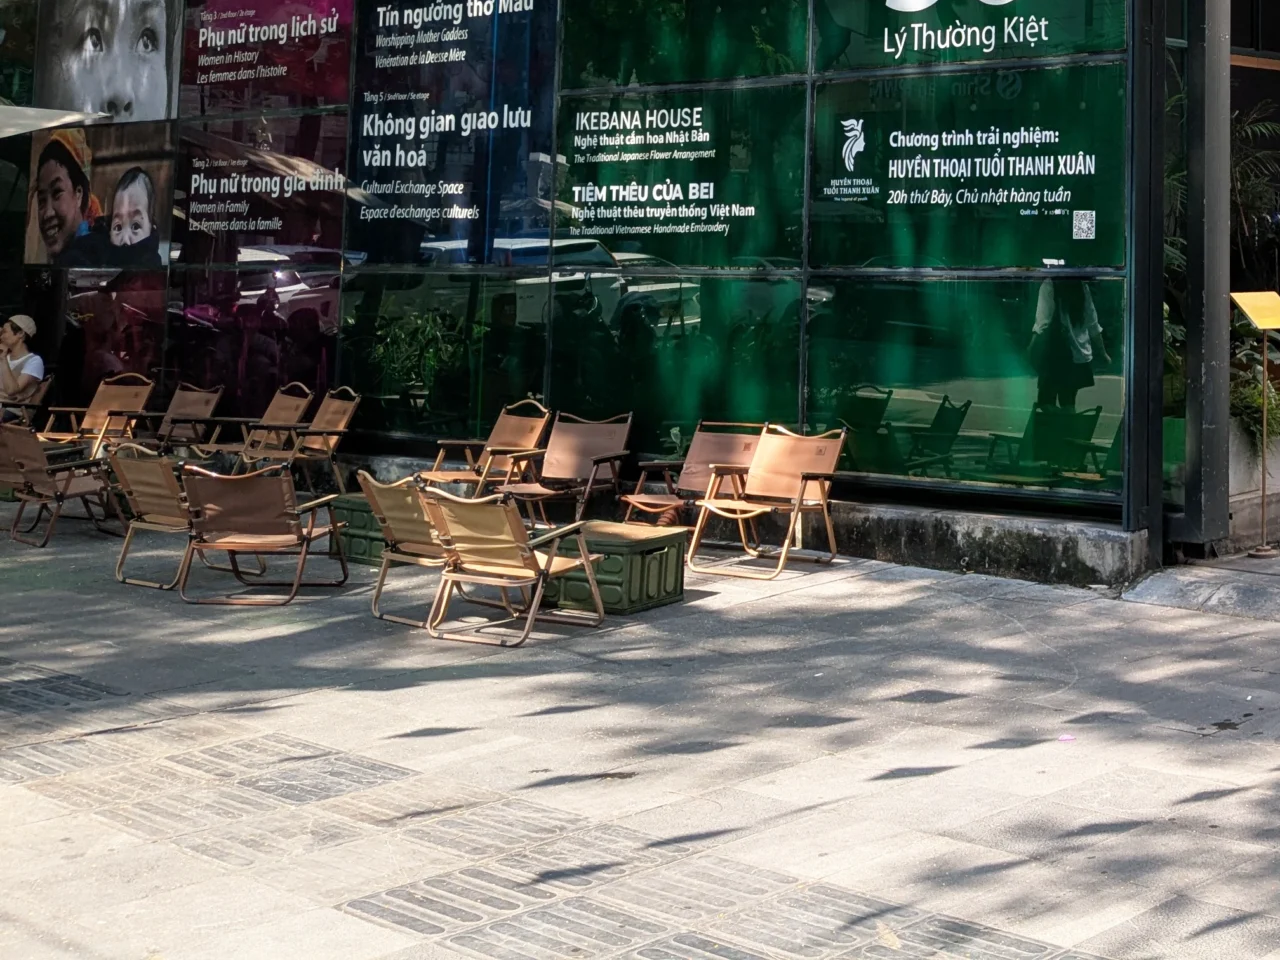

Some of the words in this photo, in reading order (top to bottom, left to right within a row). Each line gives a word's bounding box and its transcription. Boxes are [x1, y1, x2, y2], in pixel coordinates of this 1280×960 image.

[377, 5, 399, 27] Tín
[199, 27, 224, 51] Phụ
[228, 23, 247, 48] nữ
[249, 23, 287, 44] trong
[291, 14, 316, 42] lịch
[320, 7, 339, 34] sử
[884, 26, 907, 59] Lý
[911, 20, 996, 53] Thường
[1004, 15, 1049, 47] Kiệt
[363, 113, 415, 140] Không
[419, 110, 455, 139] gian
[503, 104, 531, 128] lưu
[576, 111, 641, 130] IKEBANA
[646, 107, 702, 129] HOUSE
[889, 130, 938, 150] Chương
[941, 128, 973, 147] trình
[976, 126, 1000, 146] trải
[1004, 126, 1059, 148] nghiệm:
[363, 144, 391, 166] văn
[395, 144, 426, 167] hoá
[889, 155, 930, 178] HUYỀN
[933, 158, 971, 182] THOẠI
[974, 148, 1004, 178] TUỔI
[1008, 156, 1053, 176] THANH
[1058, 151, 1096, 176] XUÂN
[572, 182, 607, 206] TIỆM
[610, 182, 648, 202] THÊU
[652, 179, 683, 201] CỦA
[688, 182, 714, 199] BEI
[887, 189, 908, 204] 20h
[910, 189, 930, 204] thứ
[930, 189, 953, 207] Bảy,
[956, 189, 979, 204] Chủ
[980, 188, 1008, 206] nhật
[1010, 187, 1040, 205] hàng
[1043, 186, 1071, 202] tuần
